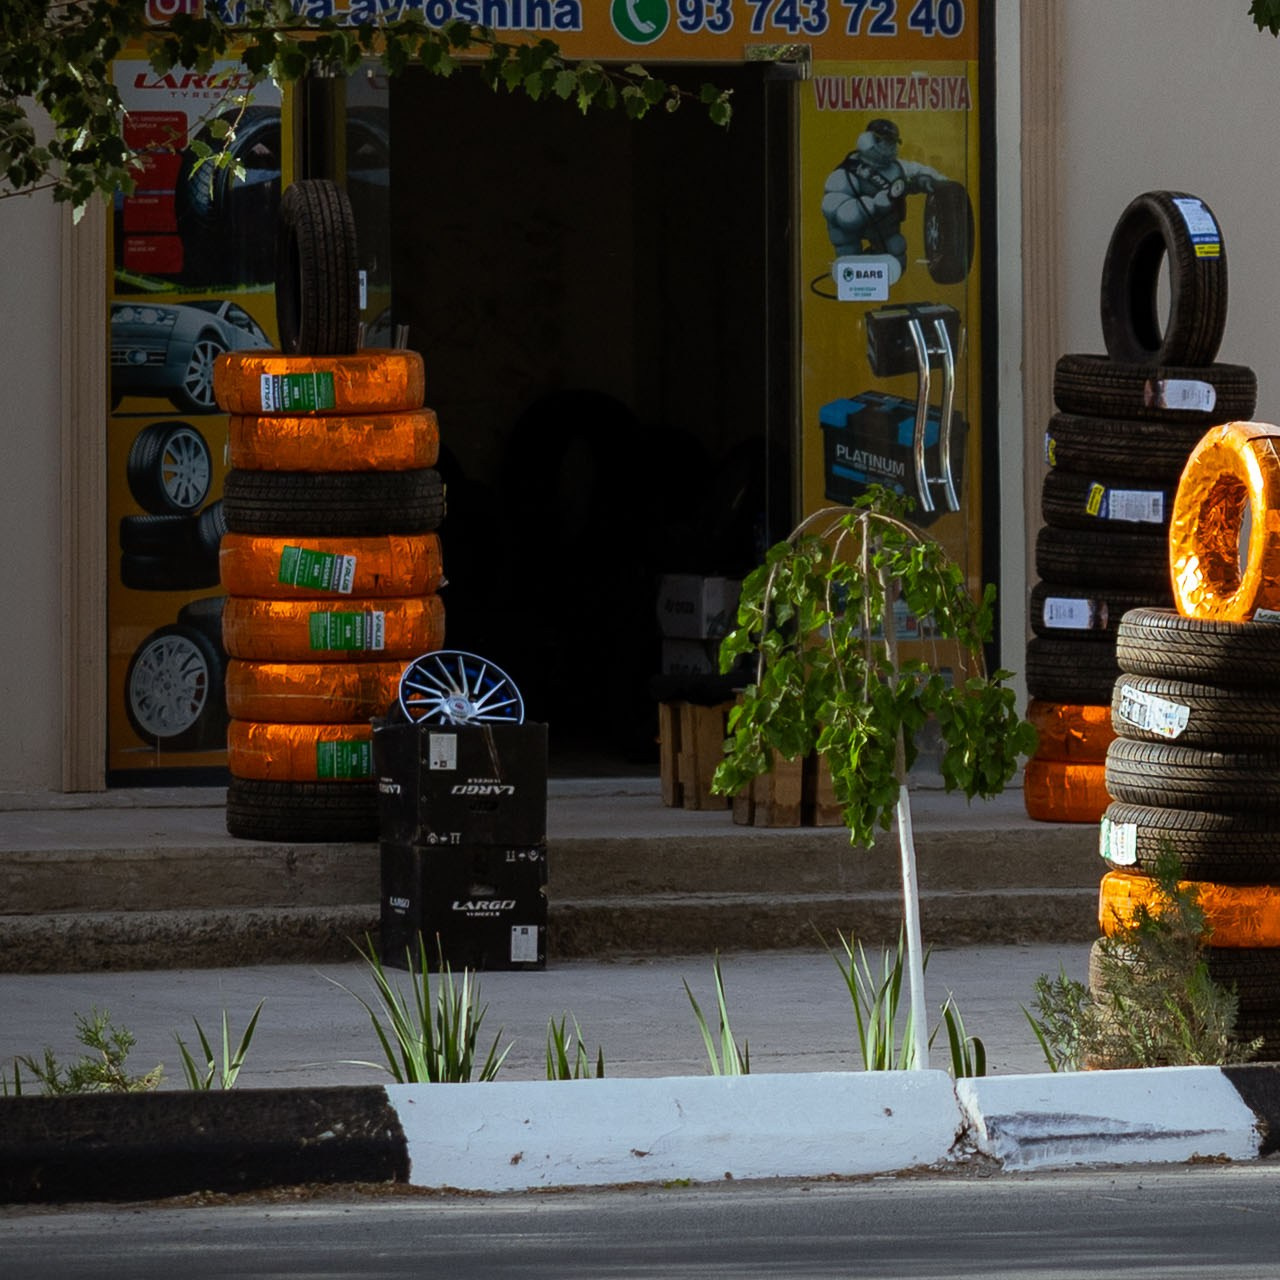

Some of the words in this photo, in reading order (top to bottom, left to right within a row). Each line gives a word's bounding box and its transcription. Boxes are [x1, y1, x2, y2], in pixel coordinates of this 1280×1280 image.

[814, 75, 972, 111] VULKANIZATSIYA
[856, 270, 883, 279] BARS
[836, 442, 905, 477] PLATINUM
[451, 784, 516, 796] LARGO
[451, 899, 517, 911] LARGO
